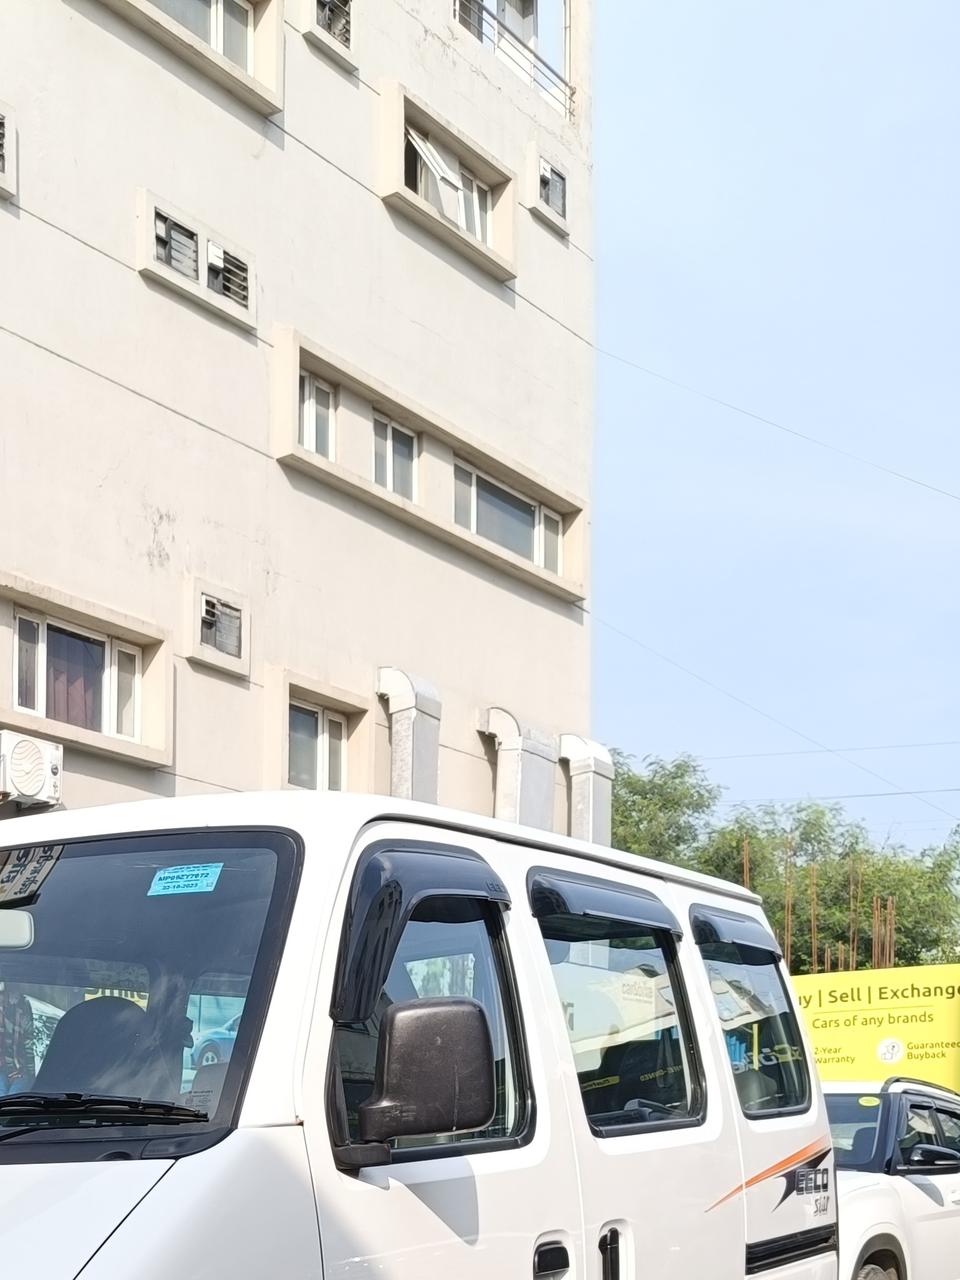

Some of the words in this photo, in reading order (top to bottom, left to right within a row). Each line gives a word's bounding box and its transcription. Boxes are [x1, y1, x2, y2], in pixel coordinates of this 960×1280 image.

[828, 986, 862, 1004] Sell
[878, 983, 960, 1001] Exchang
[812, 1017, 840, 1029] Cars
[843, 1014, 858, 1027] of
[861, 1016, 884, 1028] any
[887, 1011, 934, 1025] brands
[814, 1047, 843, 1055] 2-Year
[906, 1050, 947, 1061] Buyback
